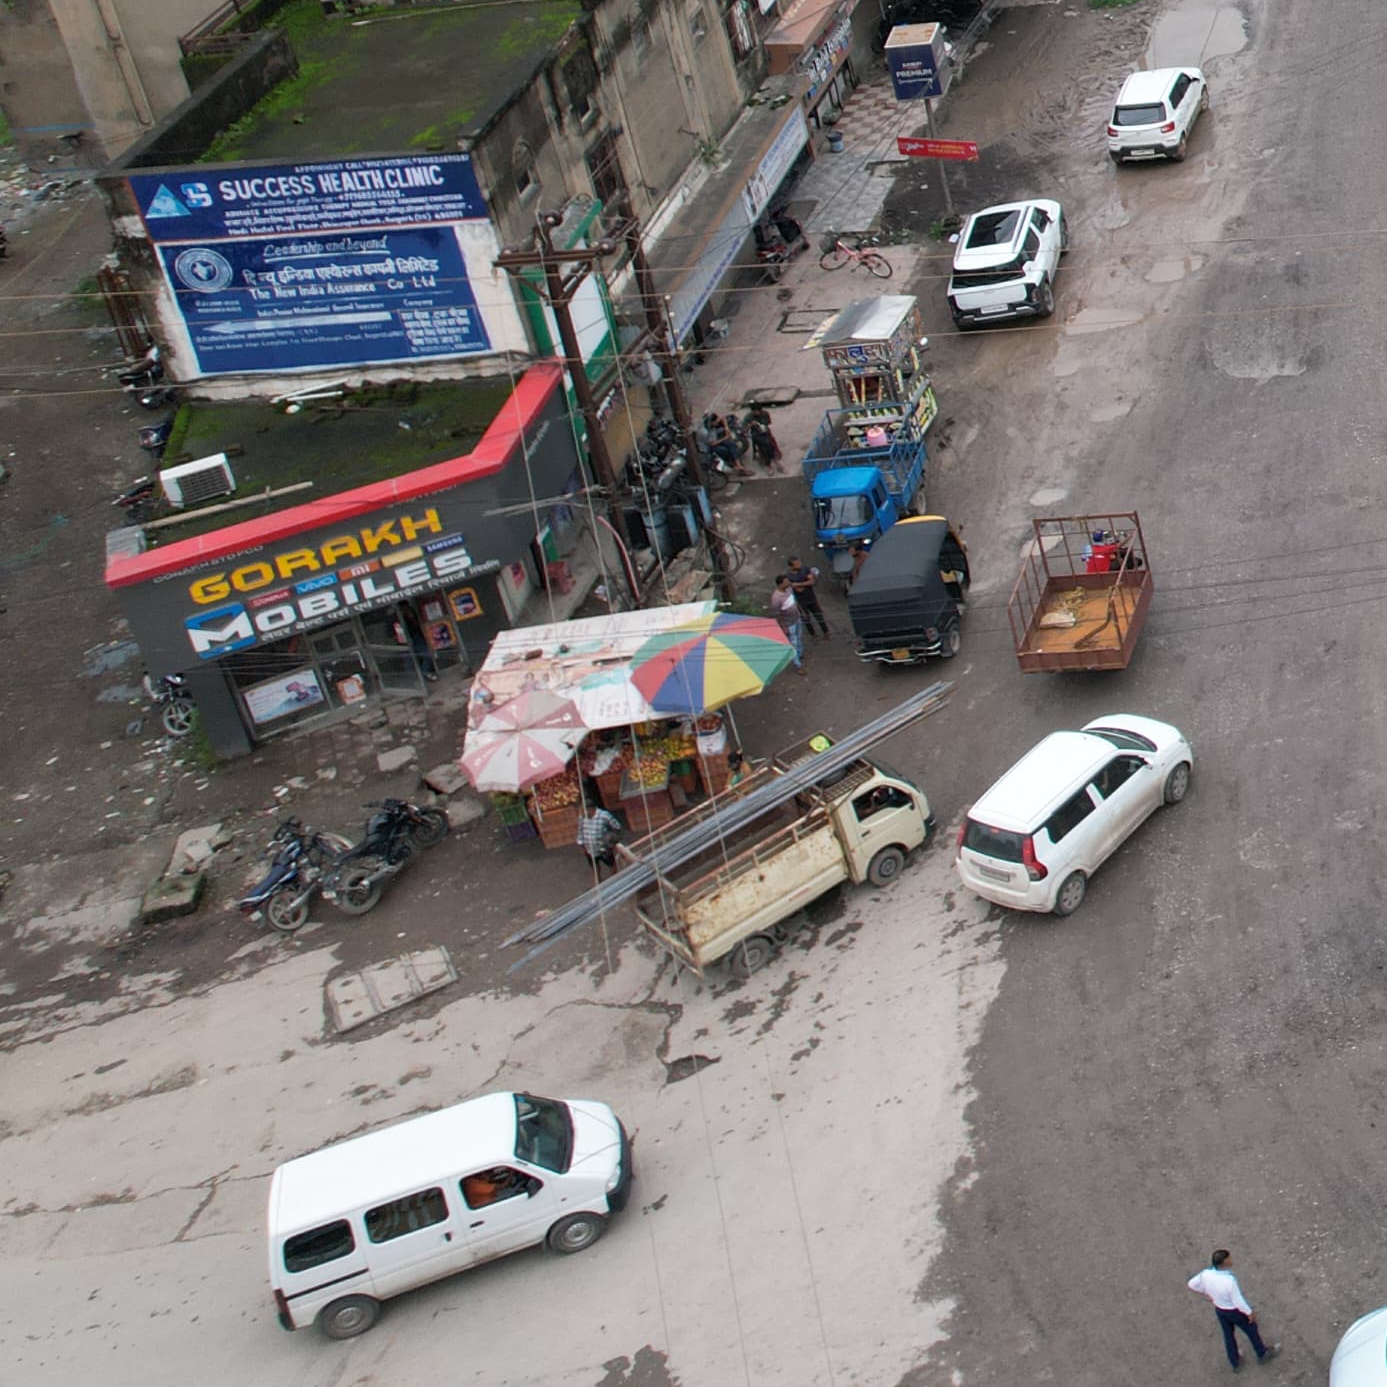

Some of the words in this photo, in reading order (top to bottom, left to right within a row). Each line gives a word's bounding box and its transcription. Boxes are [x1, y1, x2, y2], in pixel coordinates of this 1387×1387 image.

[896, 68, 933, 79] PREMIUM
[219, 175, 316, 200] SUCCESS
[318, 169, 385, 194] HEALTH
[384, 164, 444, 188] CLINIC
[248, 288, 270, 300] The
[274, 287, 296, 299] New
[298, 284, 325, 296] India
[327, 282, 376, 295] Assurance
[386, 278, 405, 290] Co
[412, 275, 436, 289] Ltd
[188, 508, 443, 604] GORAKH
[427, 535, 463, 552] SAMSUNG
[186, 548, 472, 653] MOBILES
